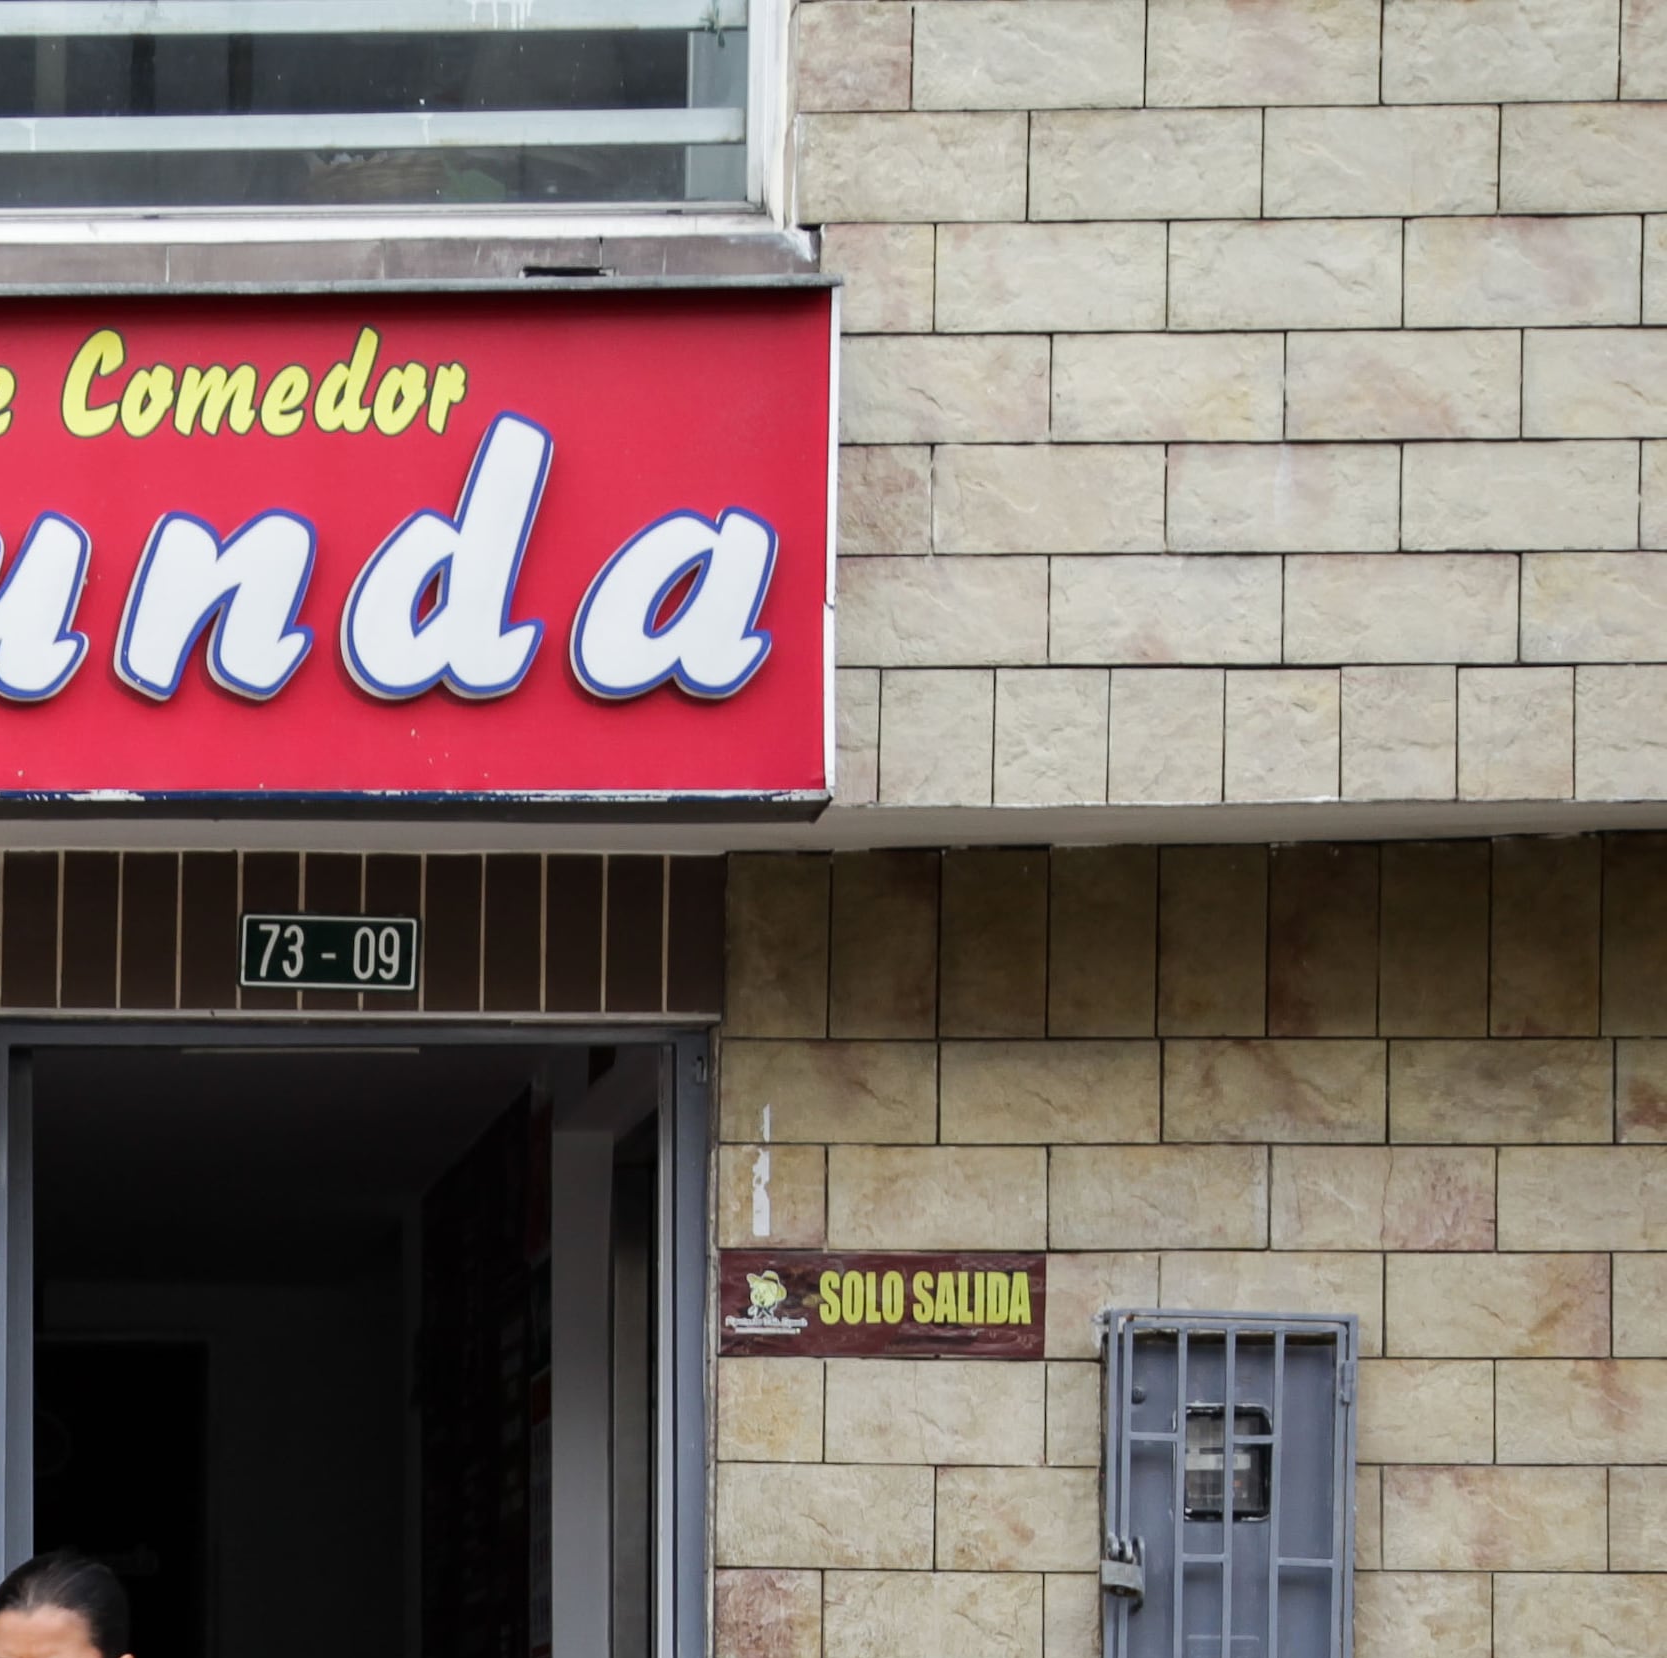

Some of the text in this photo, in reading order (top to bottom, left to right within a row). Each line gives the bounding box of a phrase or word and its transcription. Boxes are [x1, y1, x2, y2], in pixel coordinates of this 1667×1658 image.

[59, 325, 469, 440] Comedor
[258, 923, 306, 979] 73
[352, 926, 402, 981] 09
[819, 1270, 1032, 1326] SOLO SALIDA
